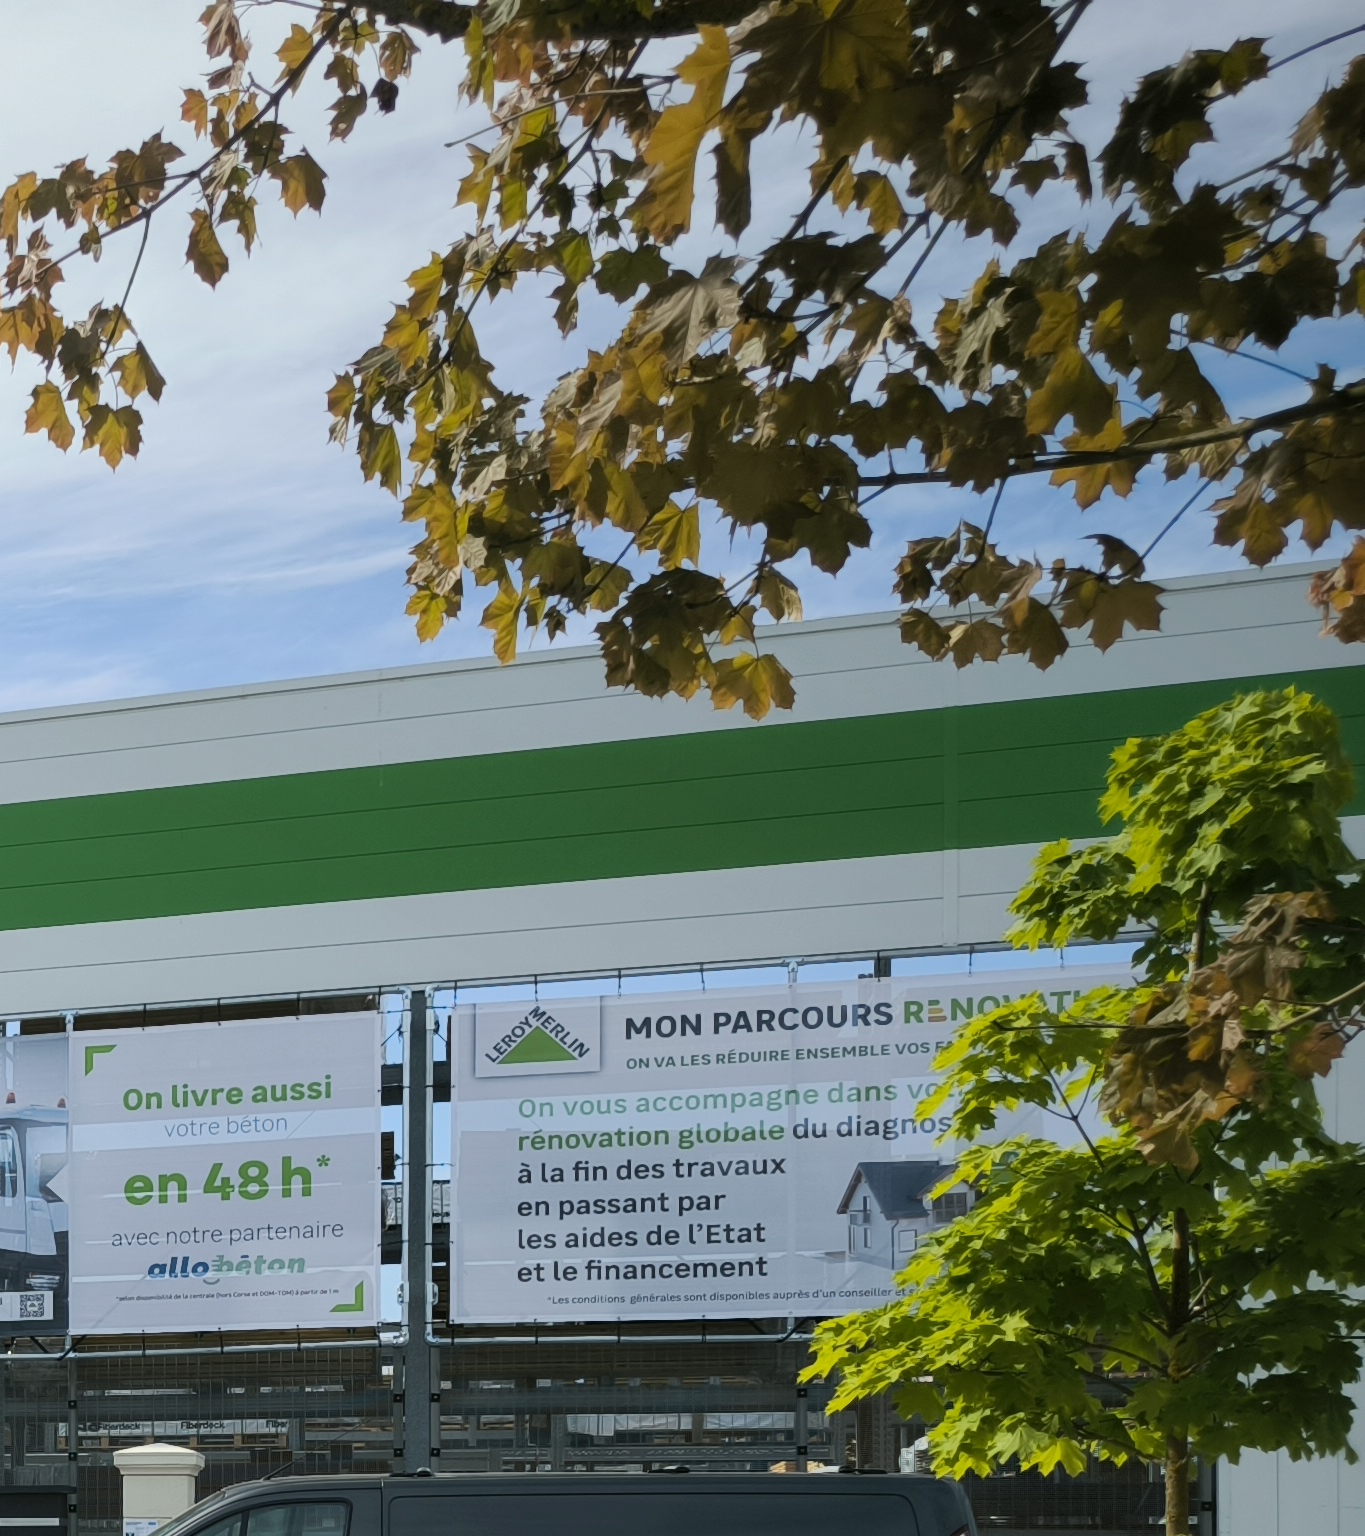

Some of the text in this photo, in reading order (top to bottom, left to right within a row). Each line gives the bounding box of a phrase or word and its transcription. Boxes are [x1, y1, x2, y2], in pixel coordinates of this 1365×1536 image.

[528, 1005, 591, 1059] MERLIN
[625, 1001, 893, 1040] MON PARCOURS
[484, 1015, 534, 1063] LEROY
[626, 1057, 650, 1070] ON
[654, 1055, 676, 1068] VA
[680, 1053, 711, 1067] LES
[715, 1048, 790, 1065] RÉDUIRE
[795, 1044, 891, 1061] ENSEMBLE
[895, 1041, 930, 1055] VOS
[123, 1074, 332, 1111] On livre aussi
[518, 1098, 554, 1118] On
[563, 1097, 627, 1117] vous
[635, 1087, 819, 1113] accompagne
[827, 1082, 898, 1104] dans
[164, 1115, 288, 1138] votre béton
[518, 1125, 670, 1151] rénovation
[677, 1120, 785, 1150] globale
[792, 1117, 828, 1139] du
[123, 1172, 188, 1206] en
[203, 1160, 270, 1201] 48
[517, 1157, 786, 1184] à la fin des travaux
[517, 1192, 726, 1220] en passant par
[111, 1221, 344, 1247] avec notre partenaire
[518, 1222, 766, 1249] les aides de l'Etat
[517, 1256, 768, 1282] et le financement
[571, 1288, 893, 1305] conditions générales sont disponibles auprès conseiller
[180, 1421, 226, 1430] Fiberdeck
